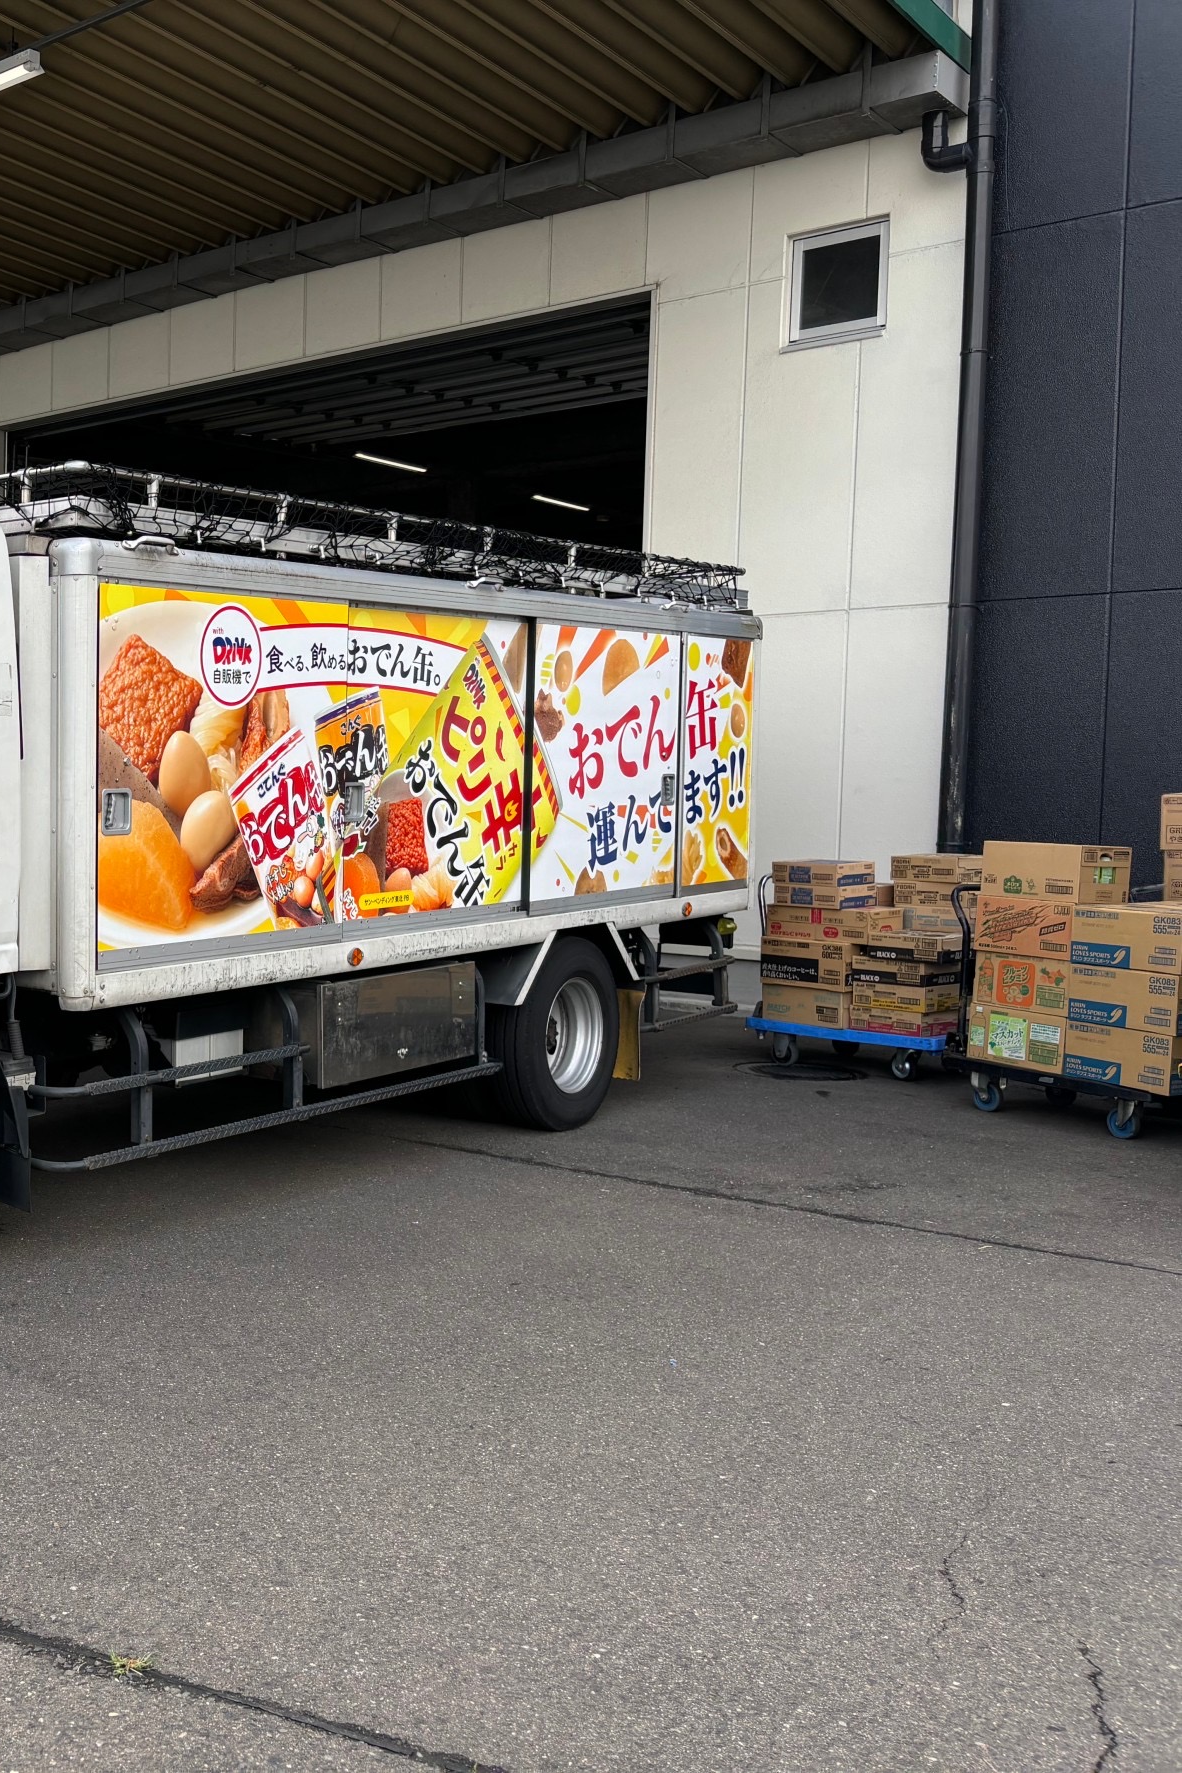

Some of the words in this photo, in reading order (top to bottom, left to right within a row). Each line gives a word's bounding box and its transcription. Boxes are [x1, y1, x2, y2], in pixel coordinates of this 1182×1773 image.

[212, 627, 224, 635] with
[212, 636, 252, 666] DRINK
[213, 668, 252, 685] 自販機で
[568, 678, 718, 800] おでん缶
[256, 761, 287, 799] こてんぐ
[1153, 916, 1181, 926] GK083
[876, 950, 891, 959] BLACK
[1089, 951, 1111, 959] SPORTS
[1004, 964, 1029, 977] フルーツ
[1149, 976, 1176, 986] GK083
[1087, 1009, 1108, 1017] SPORTS
[991, 1027, 1024, 1040] マスカット
[1143, 1035, 1170, 1046] GK083
[1082, 1065, 1102, 1073] SPORTS
